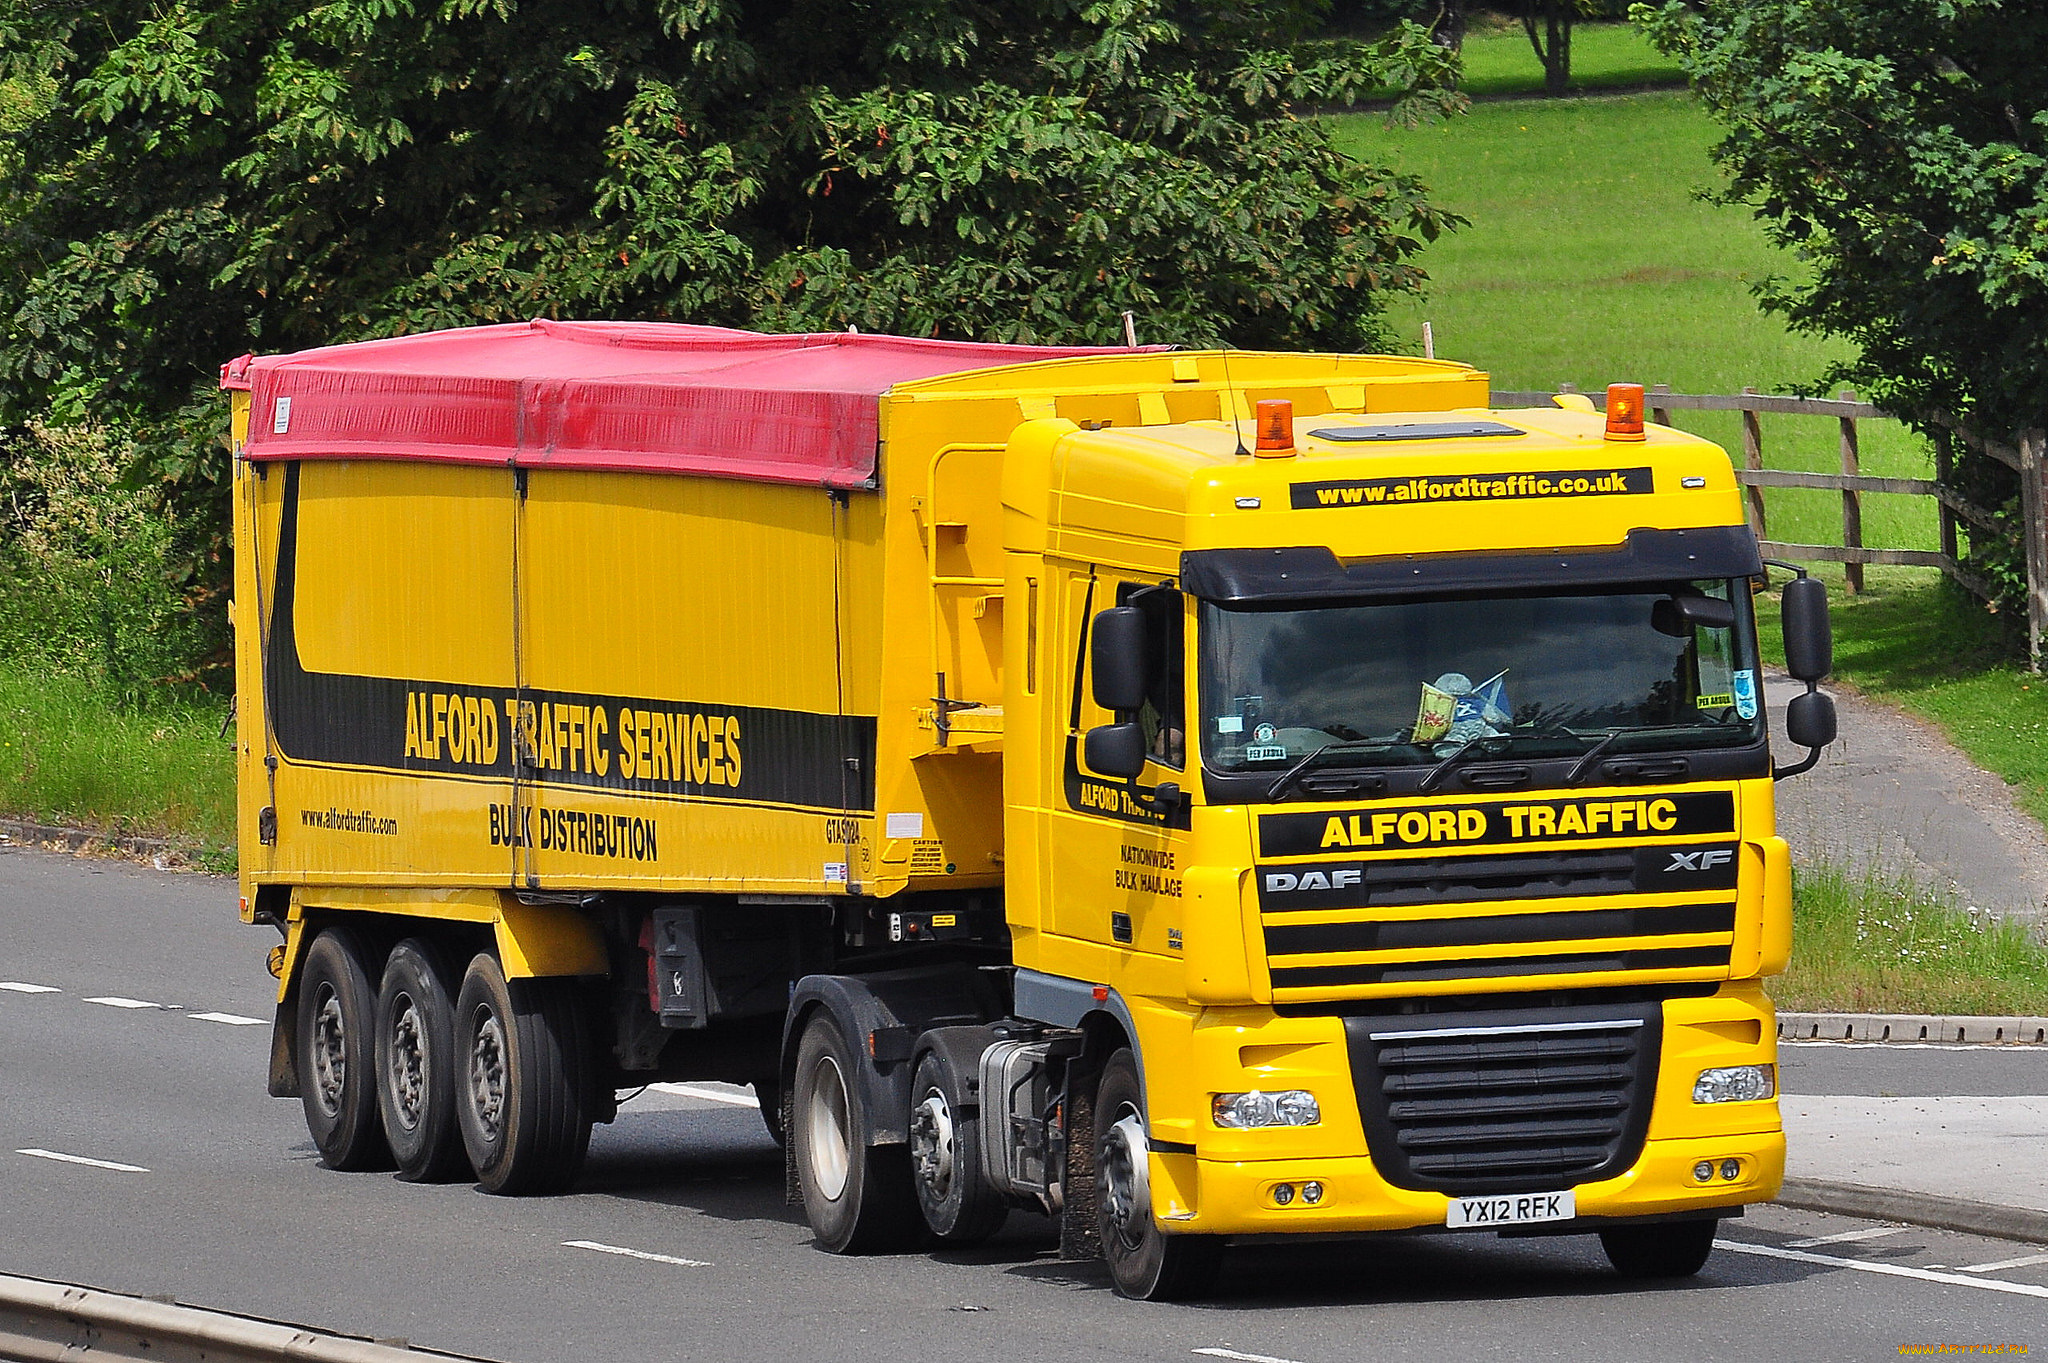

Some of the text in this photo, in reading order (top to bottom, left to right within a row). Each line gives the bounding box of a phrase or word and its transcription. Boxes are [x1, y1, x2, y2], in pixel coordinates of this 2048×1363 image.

[1316, 471, 1627, 505] www.alfordtraffic.co.uk
[404, 691, 499, 765] ALFORD
[618, 706, 742, 789] SERVICES
[1080, 782, 1119, 812] ALFORD
[300, 806, 398, 836] www.alfordtraffic.com
[540, 807, 658, 863] DISTRIBUTION
[1320, 798, 1678, 848] ALFORD TRAFFIC
[1120, 844, 1175, 871] NATIONWIDE
[1663, 849, 1733, 872] XF
[1115, 869, 1183, 898] BULK HAULAGE
[1265, 868, 1364, 893] DAF
[1461, 1195, 1561, 1223] YX12 RFK
